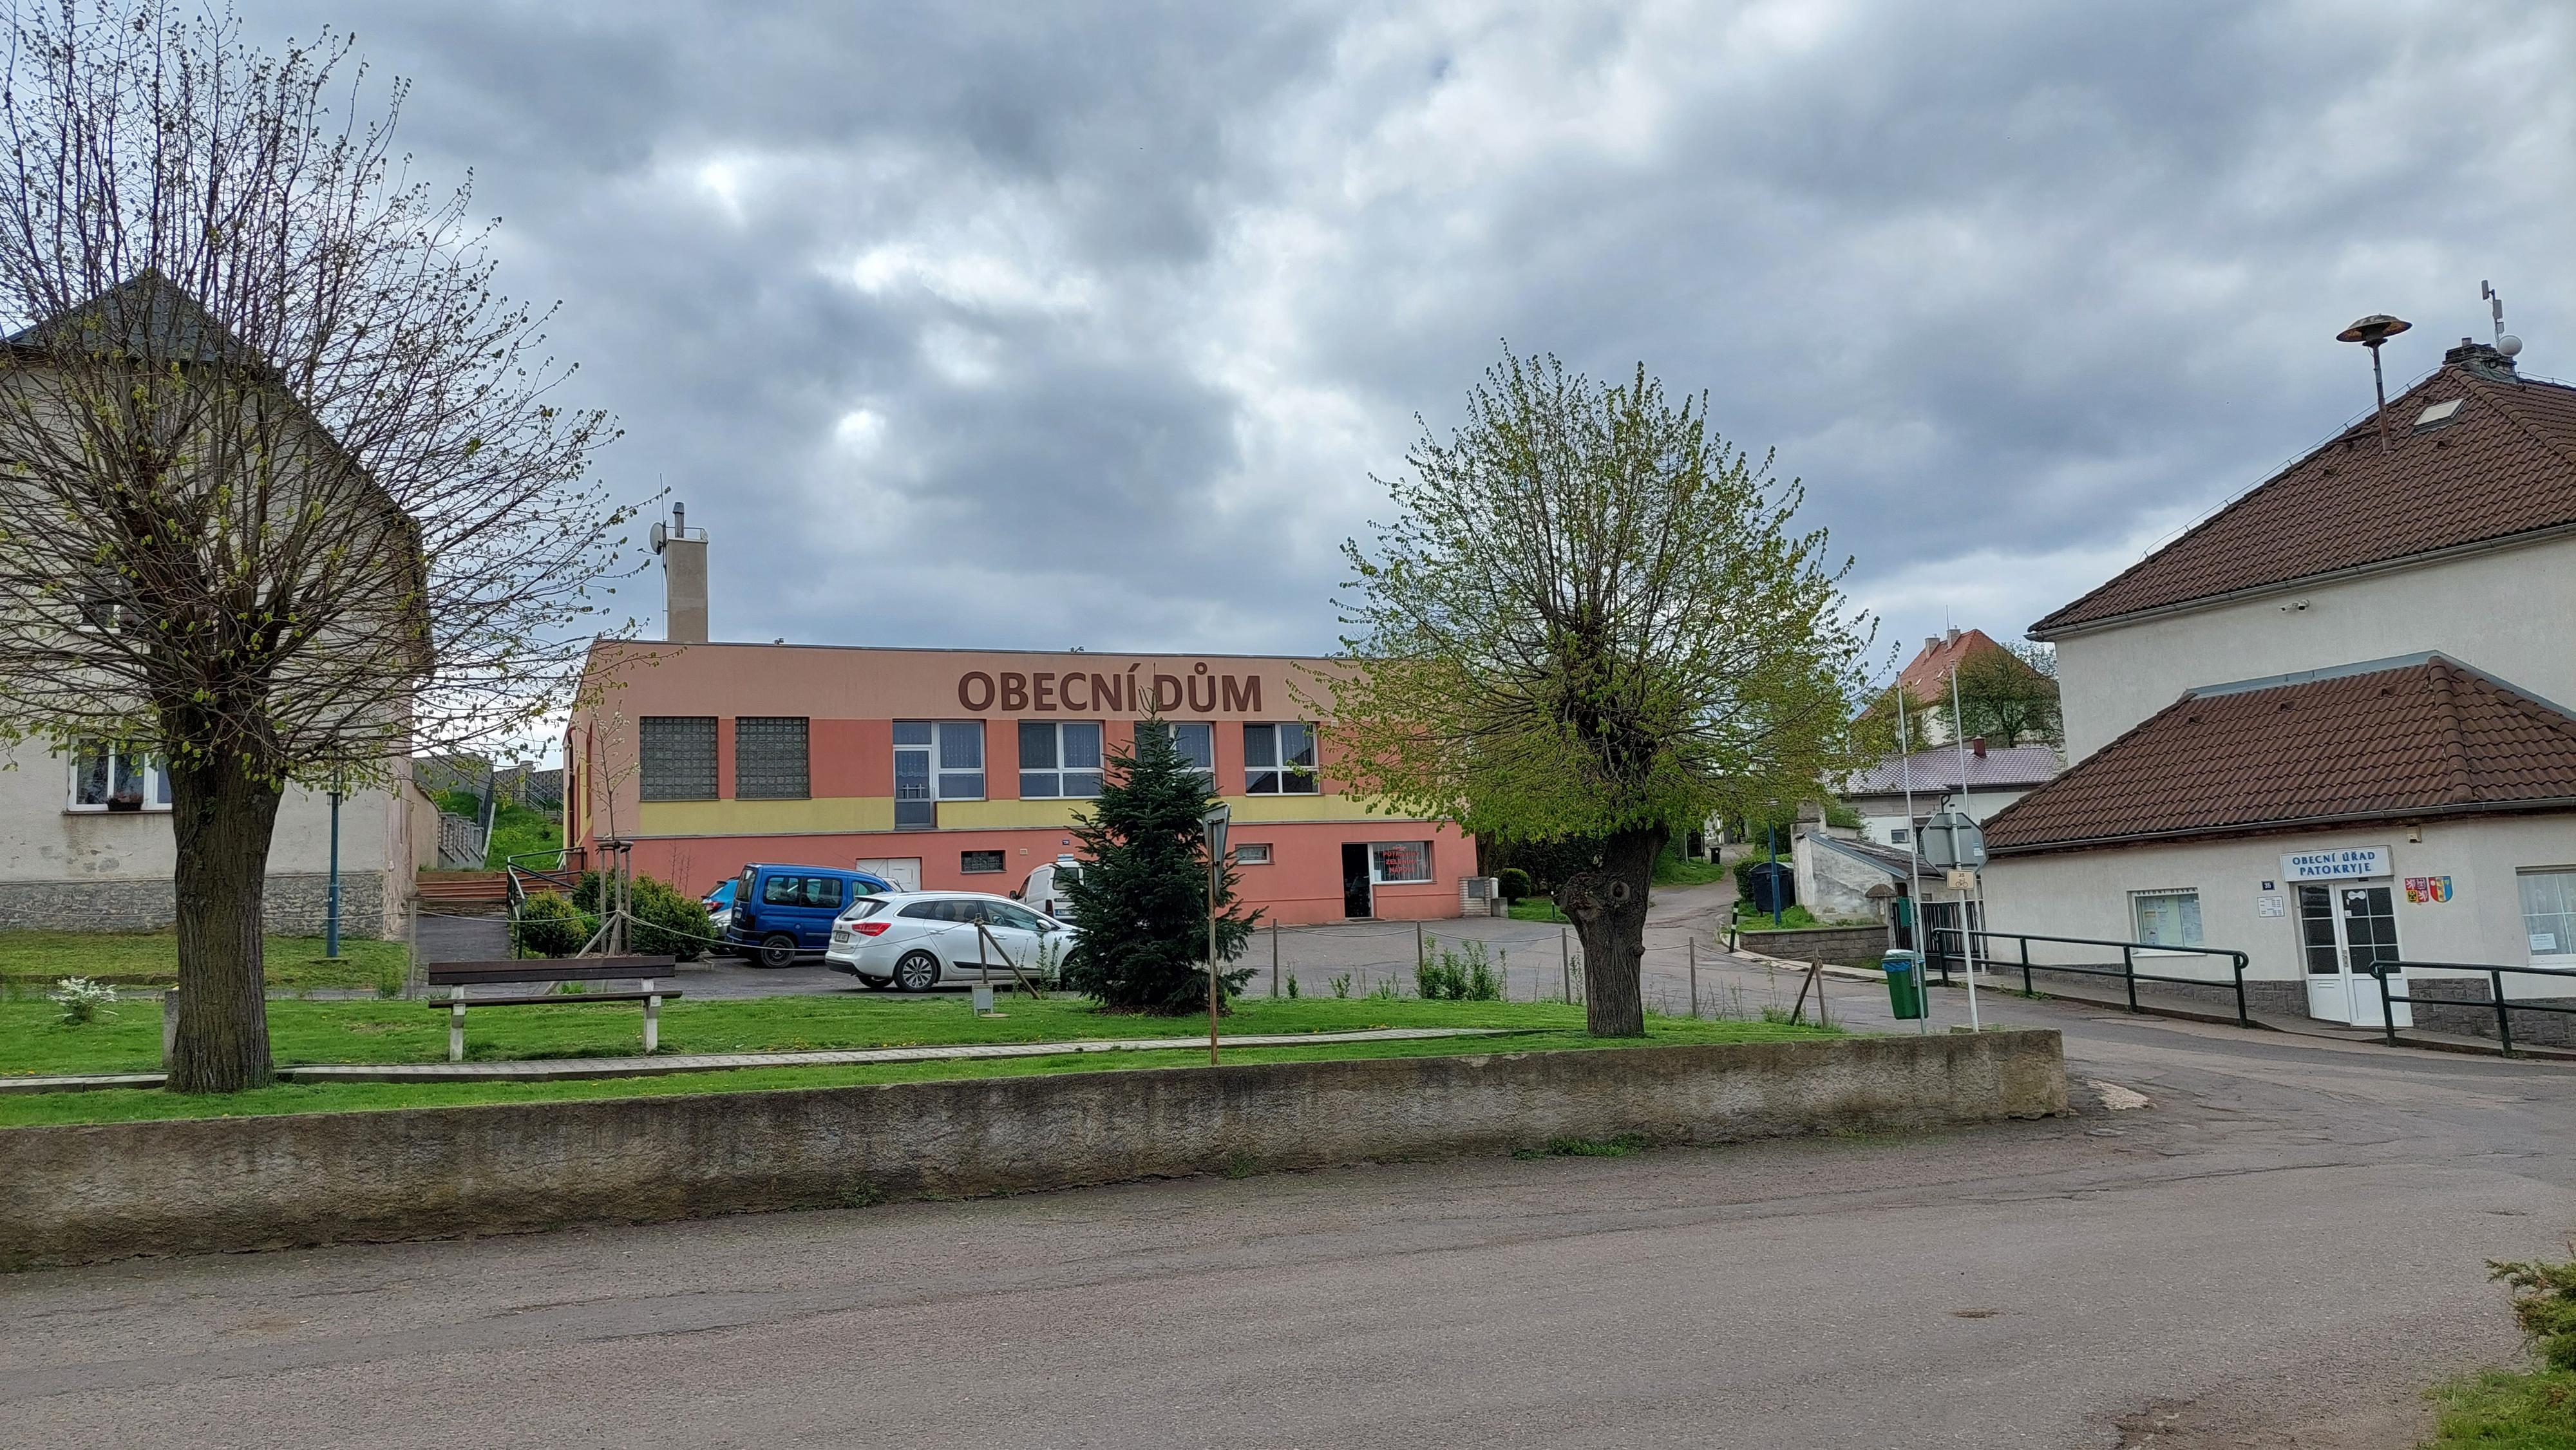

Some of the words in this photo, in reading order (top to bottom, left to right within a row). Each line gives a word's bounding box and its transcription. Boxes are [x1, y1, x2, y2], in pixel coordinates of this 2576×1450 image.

[958, 663, 1141, 711] OBECNÍ
[1154, 661, 1262, 712] DŮM
[2293, 853, 2335, 865] OBECNÍ
[2342, 851, 2375, 862] ÚŘAD
[2300, 863, 2371, 876] PATOKRYJE
